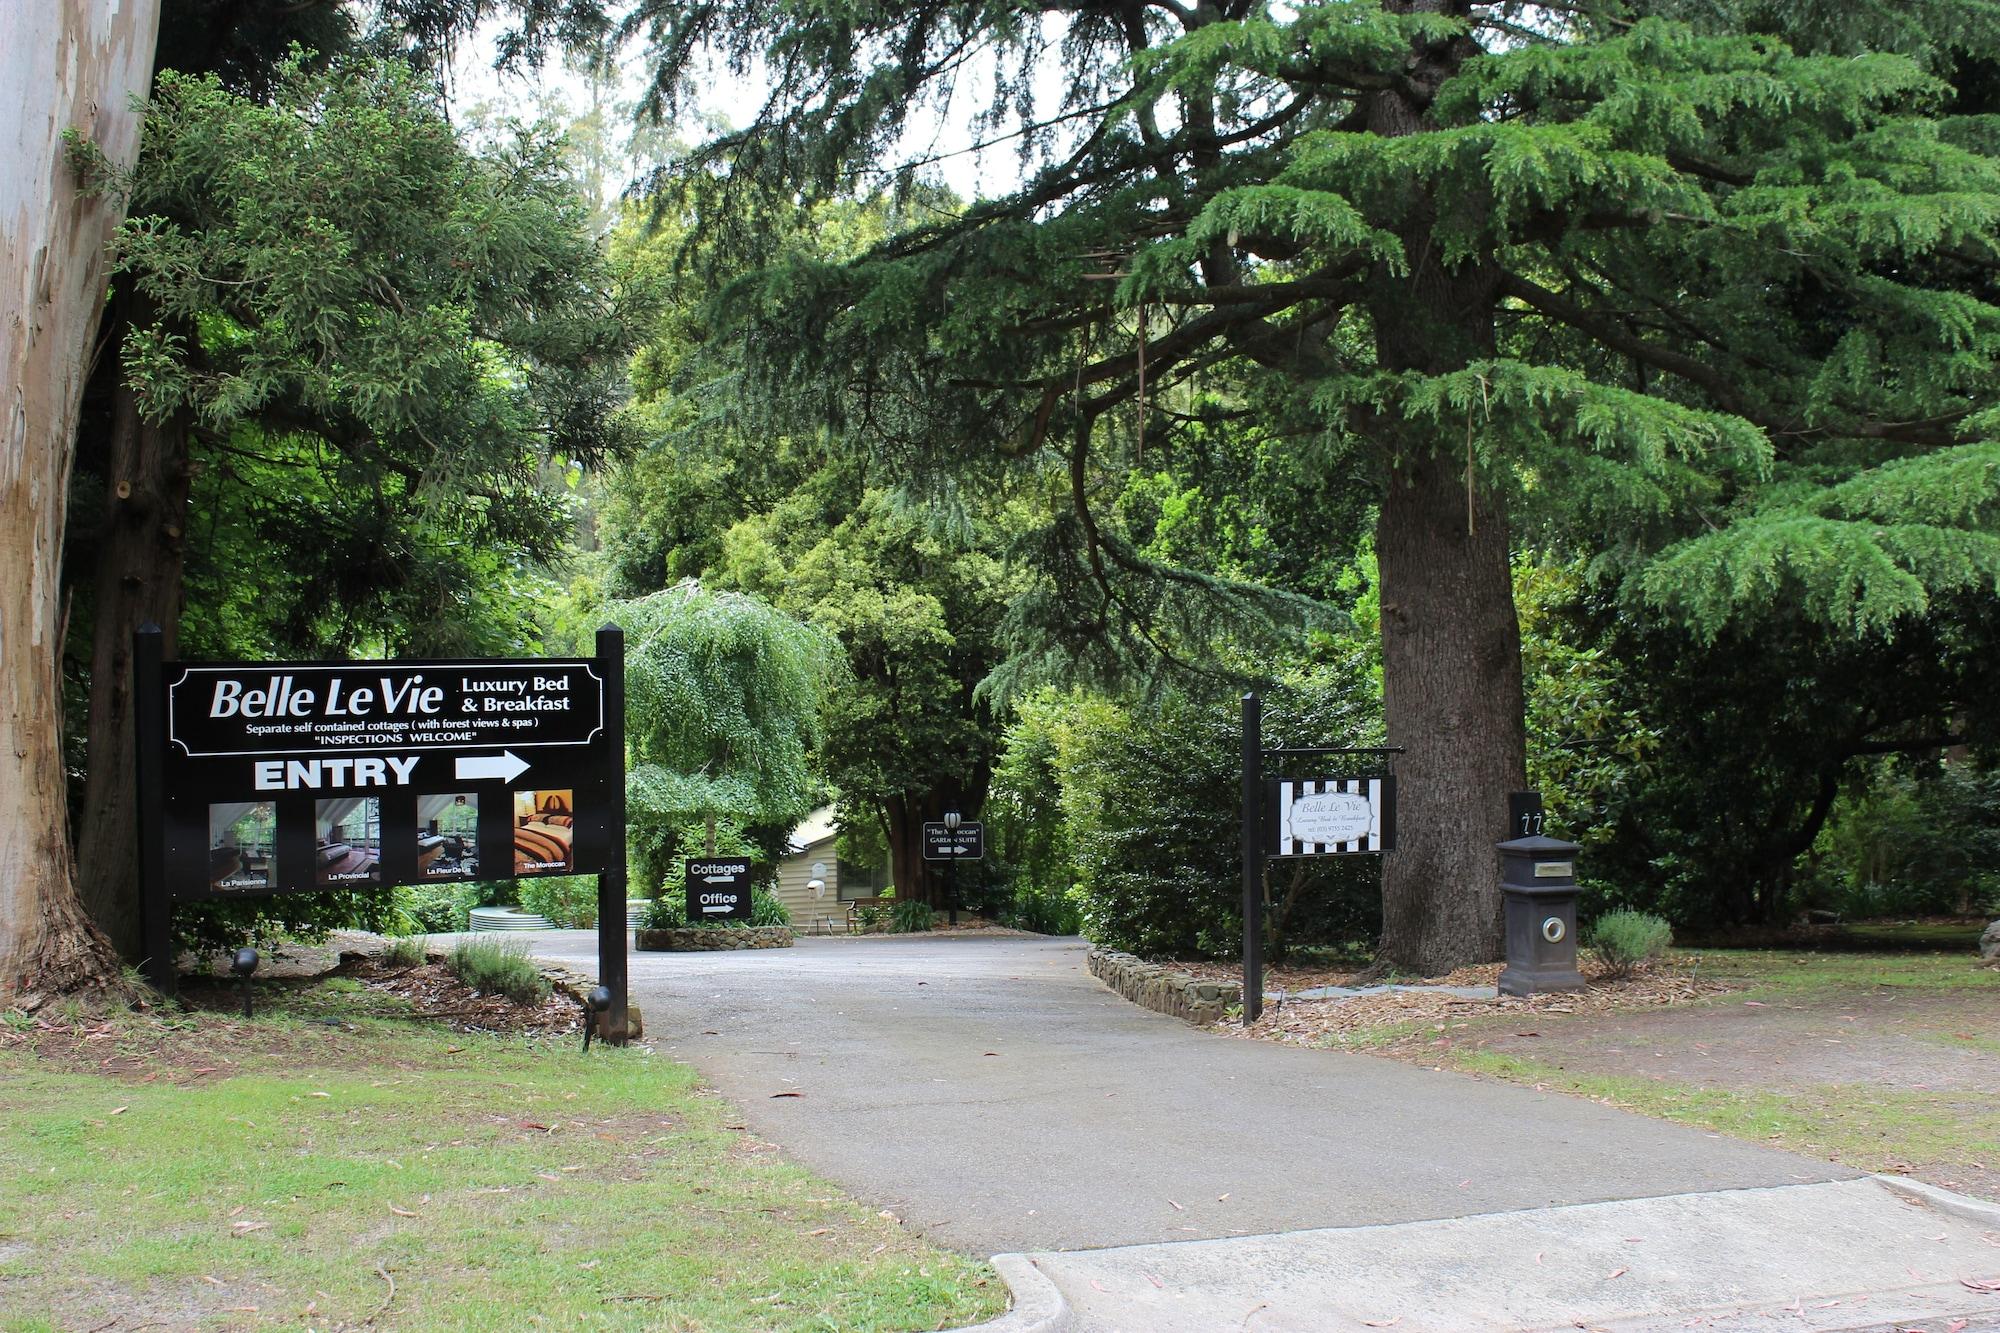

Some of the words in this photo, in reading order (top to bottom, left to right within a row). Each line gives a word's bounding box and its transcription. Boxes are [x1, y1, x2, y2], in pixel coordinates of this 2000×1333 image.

[462, 677, 528, 695] Luxury
[533, 675, 569, 691] Bed
[209, 676, 315, 718] Belle
[324, 678, 374, 716] Le
[380, 675, 444, 714] Vie
[461, 698, 478, 712] &
[484, 696, 570, 712] Breakfast
[246, 723, 292, 736] Separate
[293, 721, 313, 733] self
[314, 721, 365, 732] contained
[367, 721, 409, 733] cottages
[442, 718, 470, 729] forest
[472, 718, 500, 728] views
[501, 717, 511, 727] &
[314, 733, 403, 745] "INSPECTIONS
[409, 731, 477, 742] WELCOME"
[254, 756, 420, 790] ENTRY
[1302, 801, 1326, 813] Belle
[1328, 802, 1341, 812] Le
[1344, 800, 1361, 811] Vie
[1521, 812, 1542, 835] 77
[536, 860, 566, 868] Moroccan
[691, 864, 746, 876] Cottages
[231, 877, 267, 887] Parisienne
[328, 872, 338, 881] La
[338, 871, 370, 880] Provincial
[699, 893, 738, 904] Office
